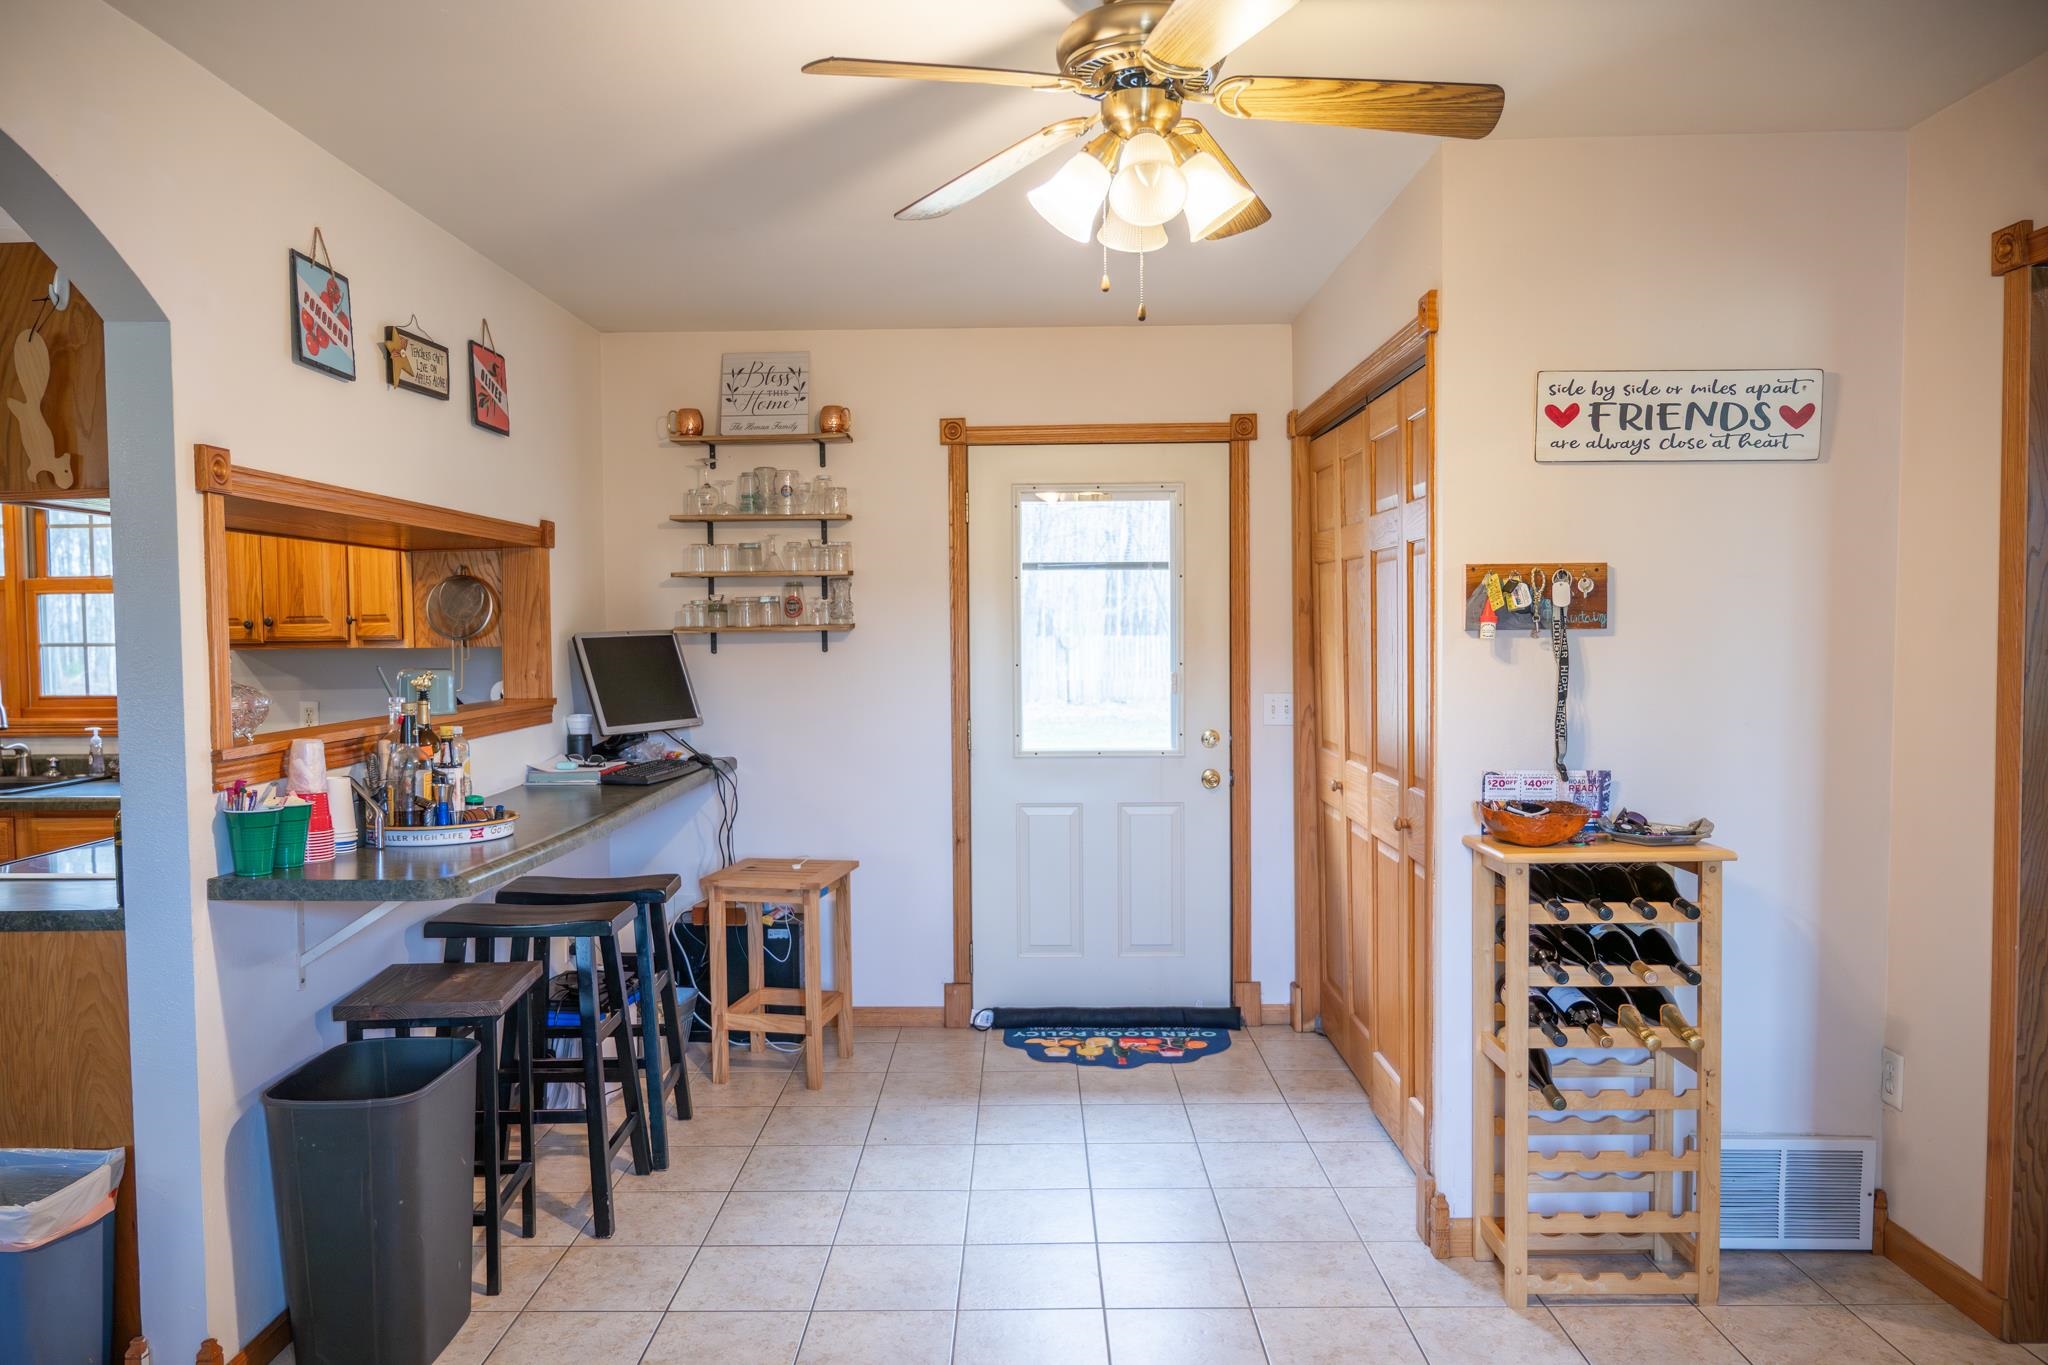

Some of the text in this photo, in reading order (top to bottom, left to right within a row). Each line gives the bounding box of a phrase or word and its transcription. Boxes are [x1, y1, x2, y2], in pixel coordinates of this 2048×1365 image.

[303, 291, 349, 348] POMODORO
[410, 343, 431, 361] TEACHERS
[416, 359, 437, 374] LIVE ON
[741, 360, 793, 388] Bless
[415, 372, 446, 388] APPLES ALONE
[481, 368, 502, 404] OLIVES
[1549, 378, 1814, 401] side by side or miles apart
[740, 389, 793, 416] Home
[729, 422, 743, 431] The
[771, 421, 799, 432] Family
[1588, 402, 1771, 432] FRIENDS
[1550, 433, 1804, 455] are always close at heart
[1488, 779, 1505, 788] $20
[1524, 779, 1542, 788] $40
